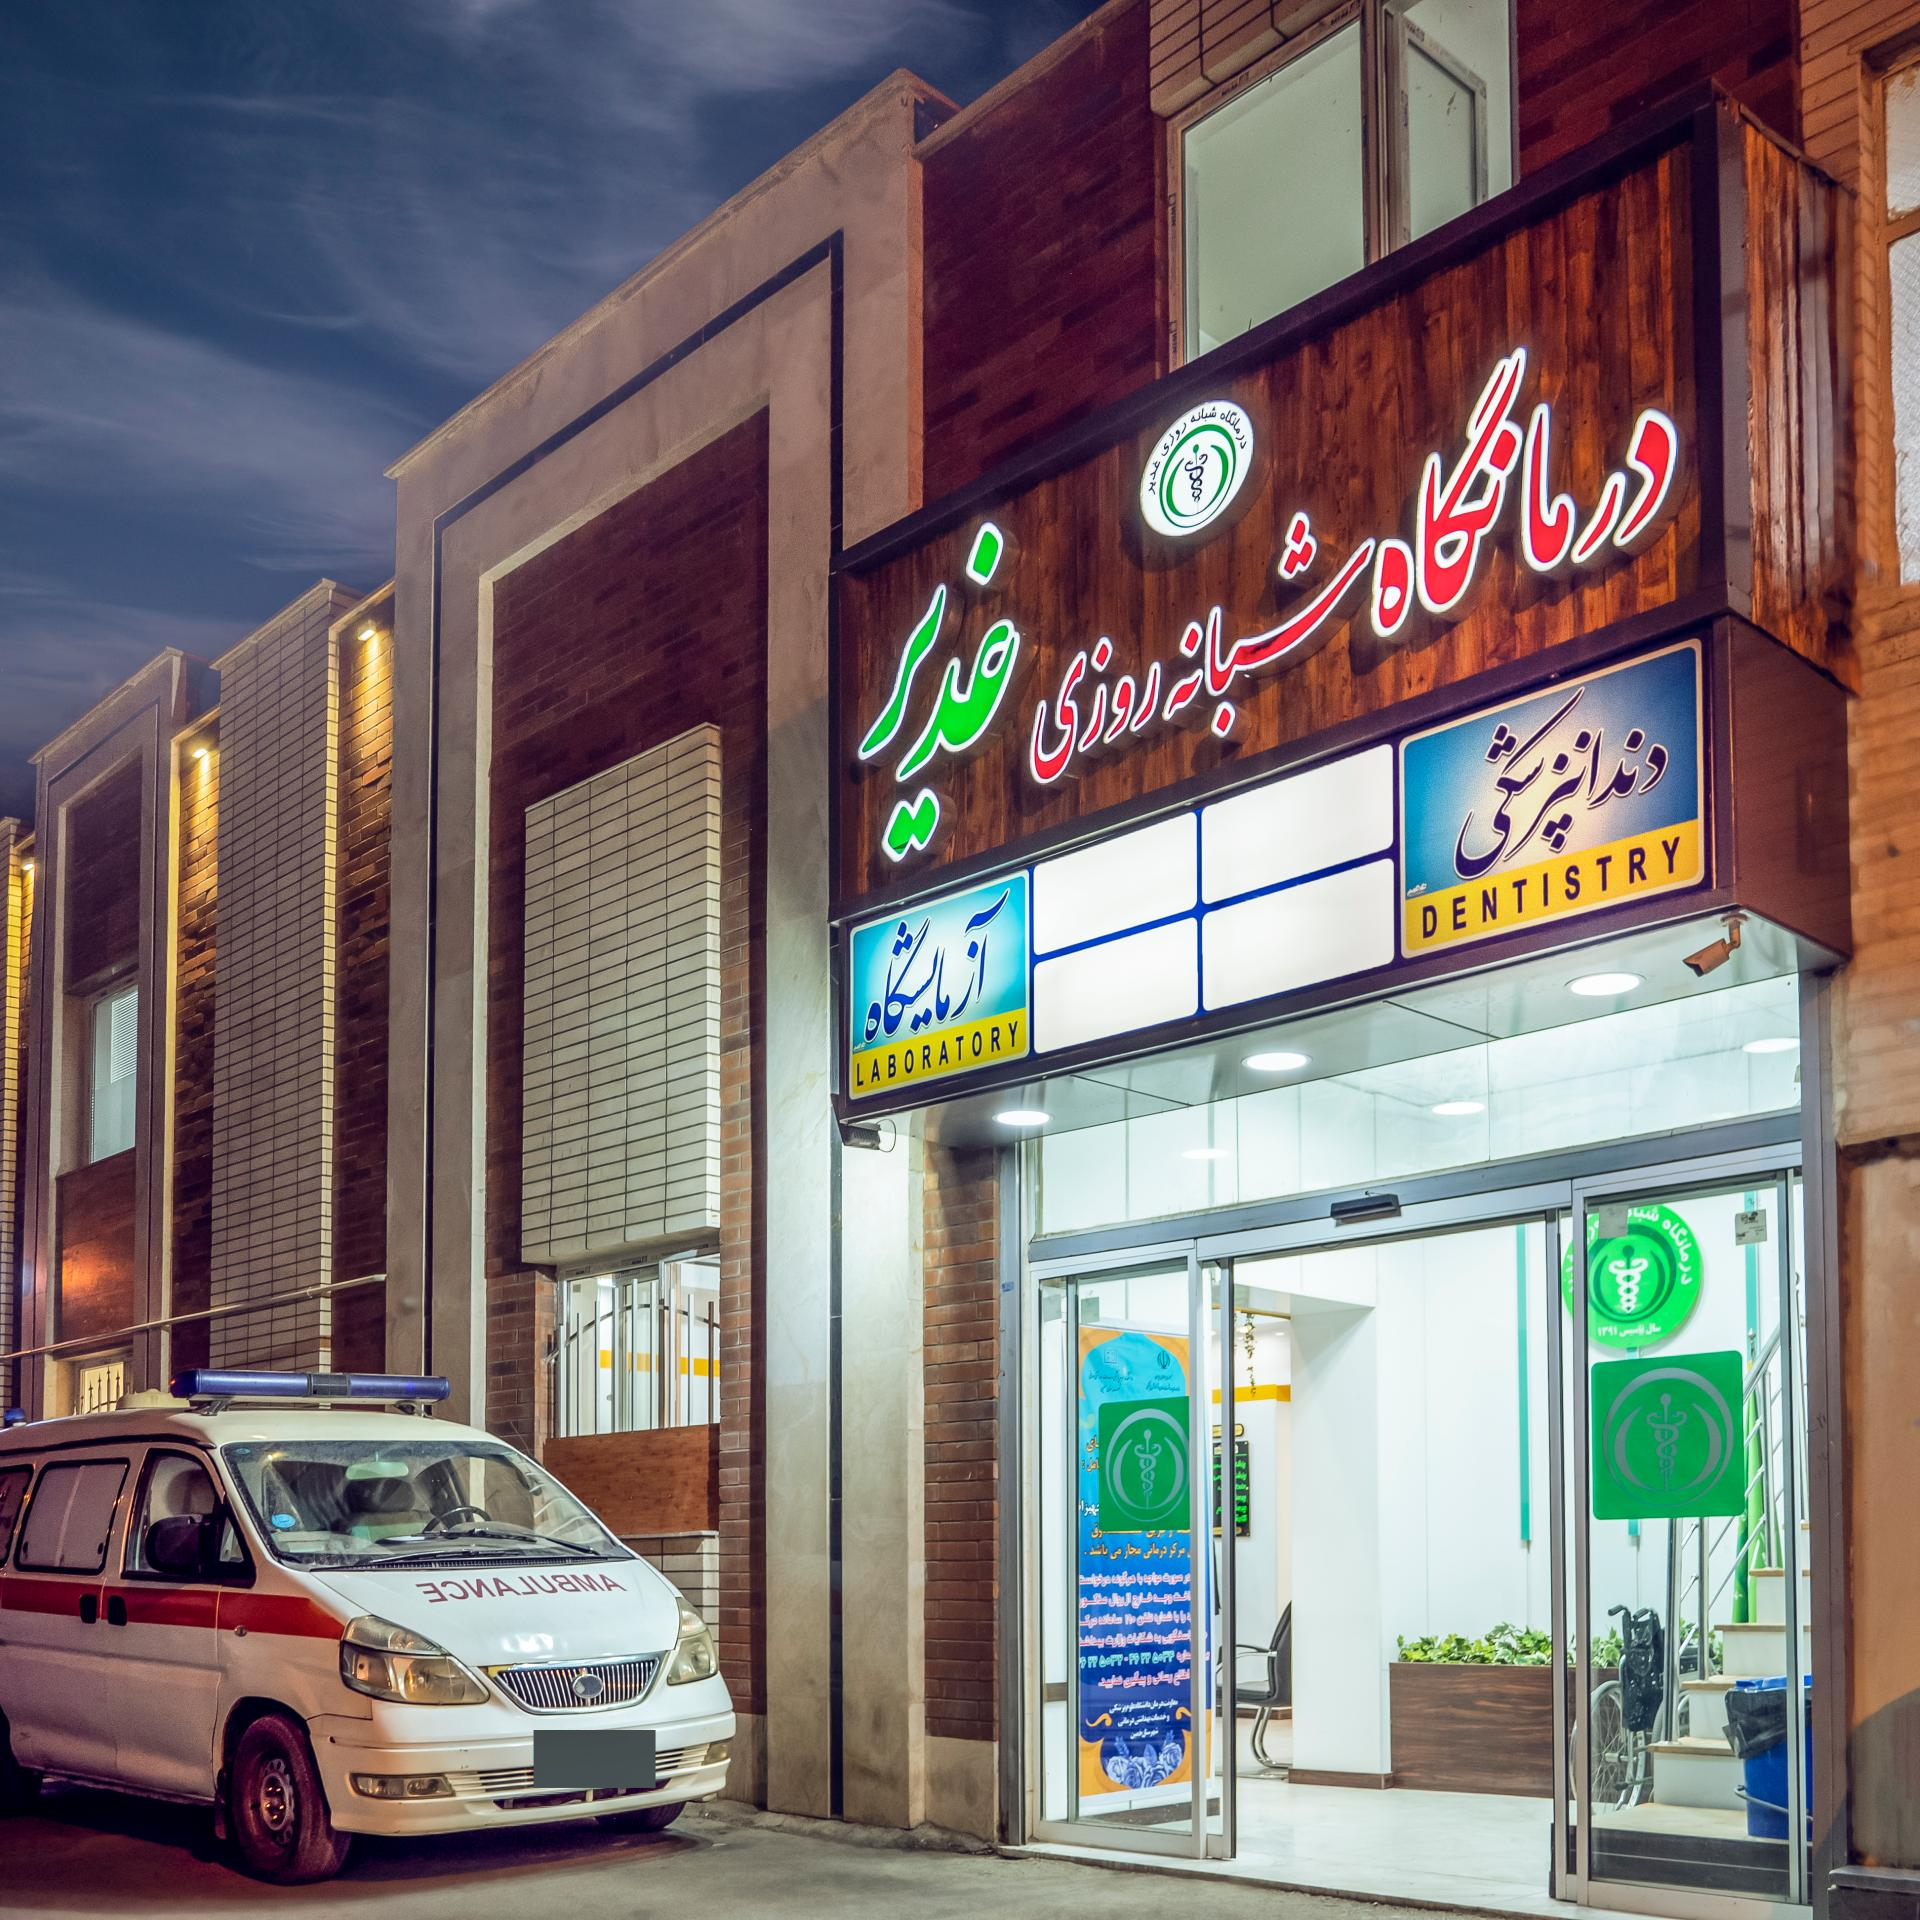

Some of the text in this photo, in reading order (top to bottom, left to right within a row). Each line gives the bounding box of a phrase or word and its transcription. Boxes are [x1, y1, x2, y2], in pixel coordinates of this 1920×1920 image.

[1161, 422, 1187, 456] روزی
[1190, 406, 1217, 423] شبانه
[1220, 410, 1247, 449] درمانگاه
[857, 347, 1678, 861] درمانگاه شبانه روزی غدیر
[1454, 686, 1668, 880] دندانپزشکی
[1422, 836, 1680, 939] DENTISTRY
[864, 887, 1010, 1043] آزمایشگاه
[856, 1021, 1018, 1087] LABORATORY
[1110, 1548, 1122, 1559] می
[1143, 1543, 1167, 1559] درمانی
